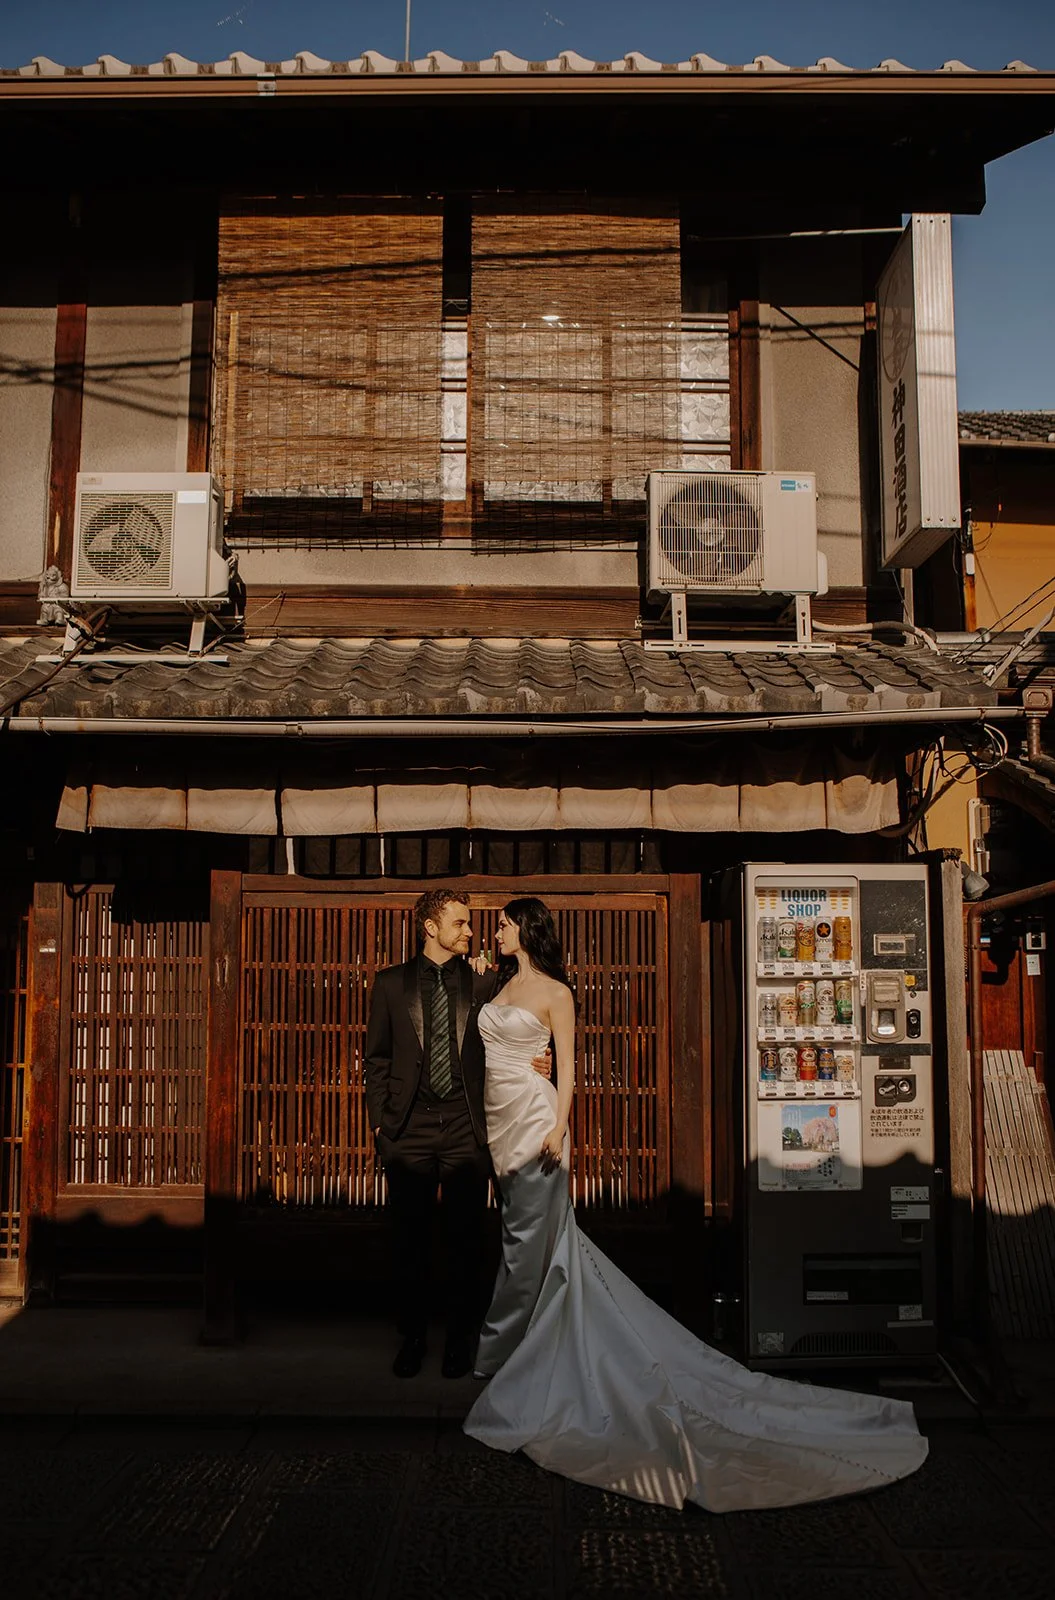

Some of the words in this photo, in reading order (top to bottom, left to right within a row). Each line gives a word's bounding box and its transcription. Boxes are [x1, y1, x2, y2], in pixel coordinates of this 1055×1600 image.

[891, 379, 907, 541] 神田酒店
[781, 889, 827, 903] LIQUOR
[787, 904, 821, 916] SHOP
